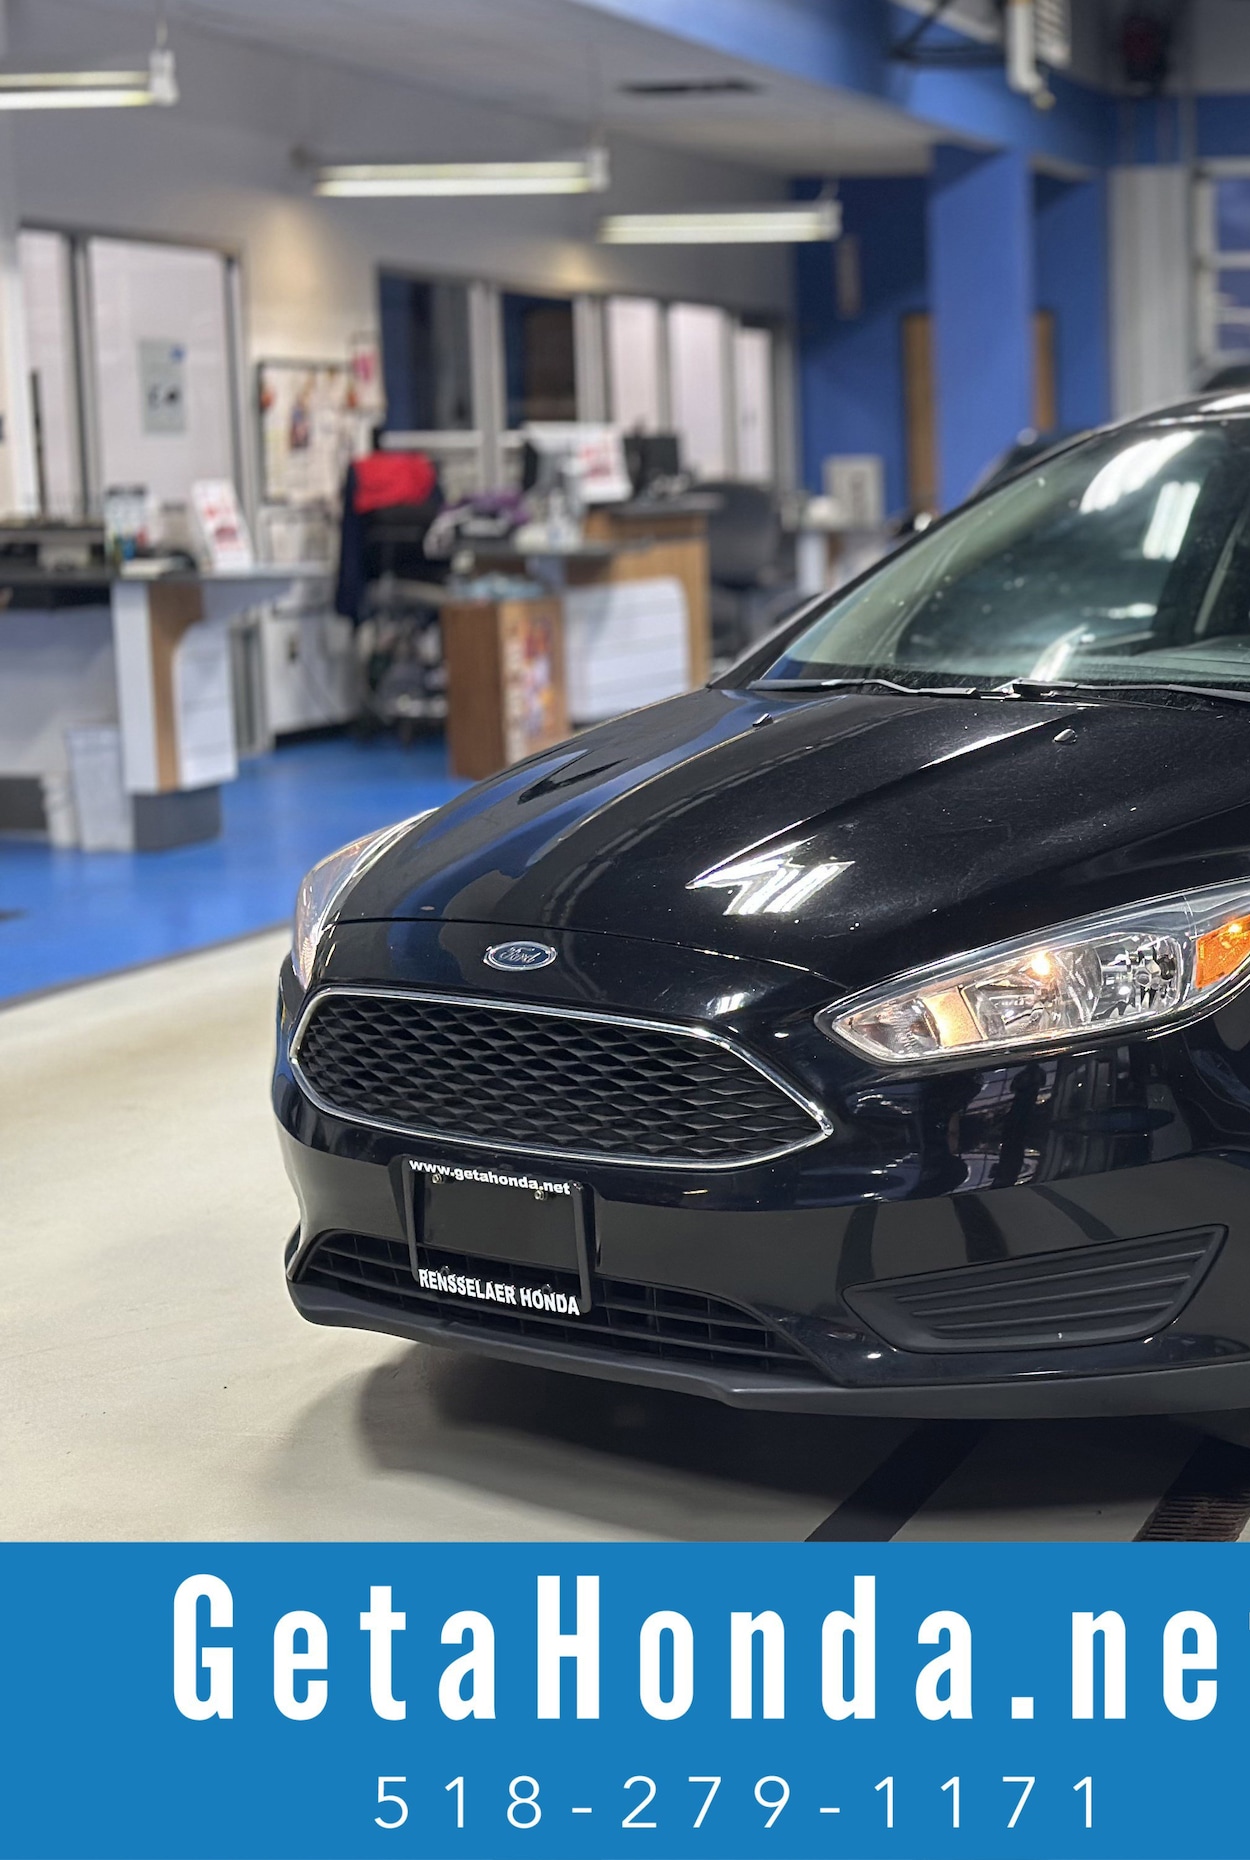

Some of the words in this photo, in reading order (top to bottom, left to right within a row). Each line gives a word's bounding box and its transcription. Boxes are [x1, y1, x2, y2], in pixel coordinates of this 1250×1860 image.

[409, 1159, 571, 1195] www.getahonda.net
[418, 1268, 517, 1305] RENSSELAER
[519, 1286, 580, 1316] HONDA
